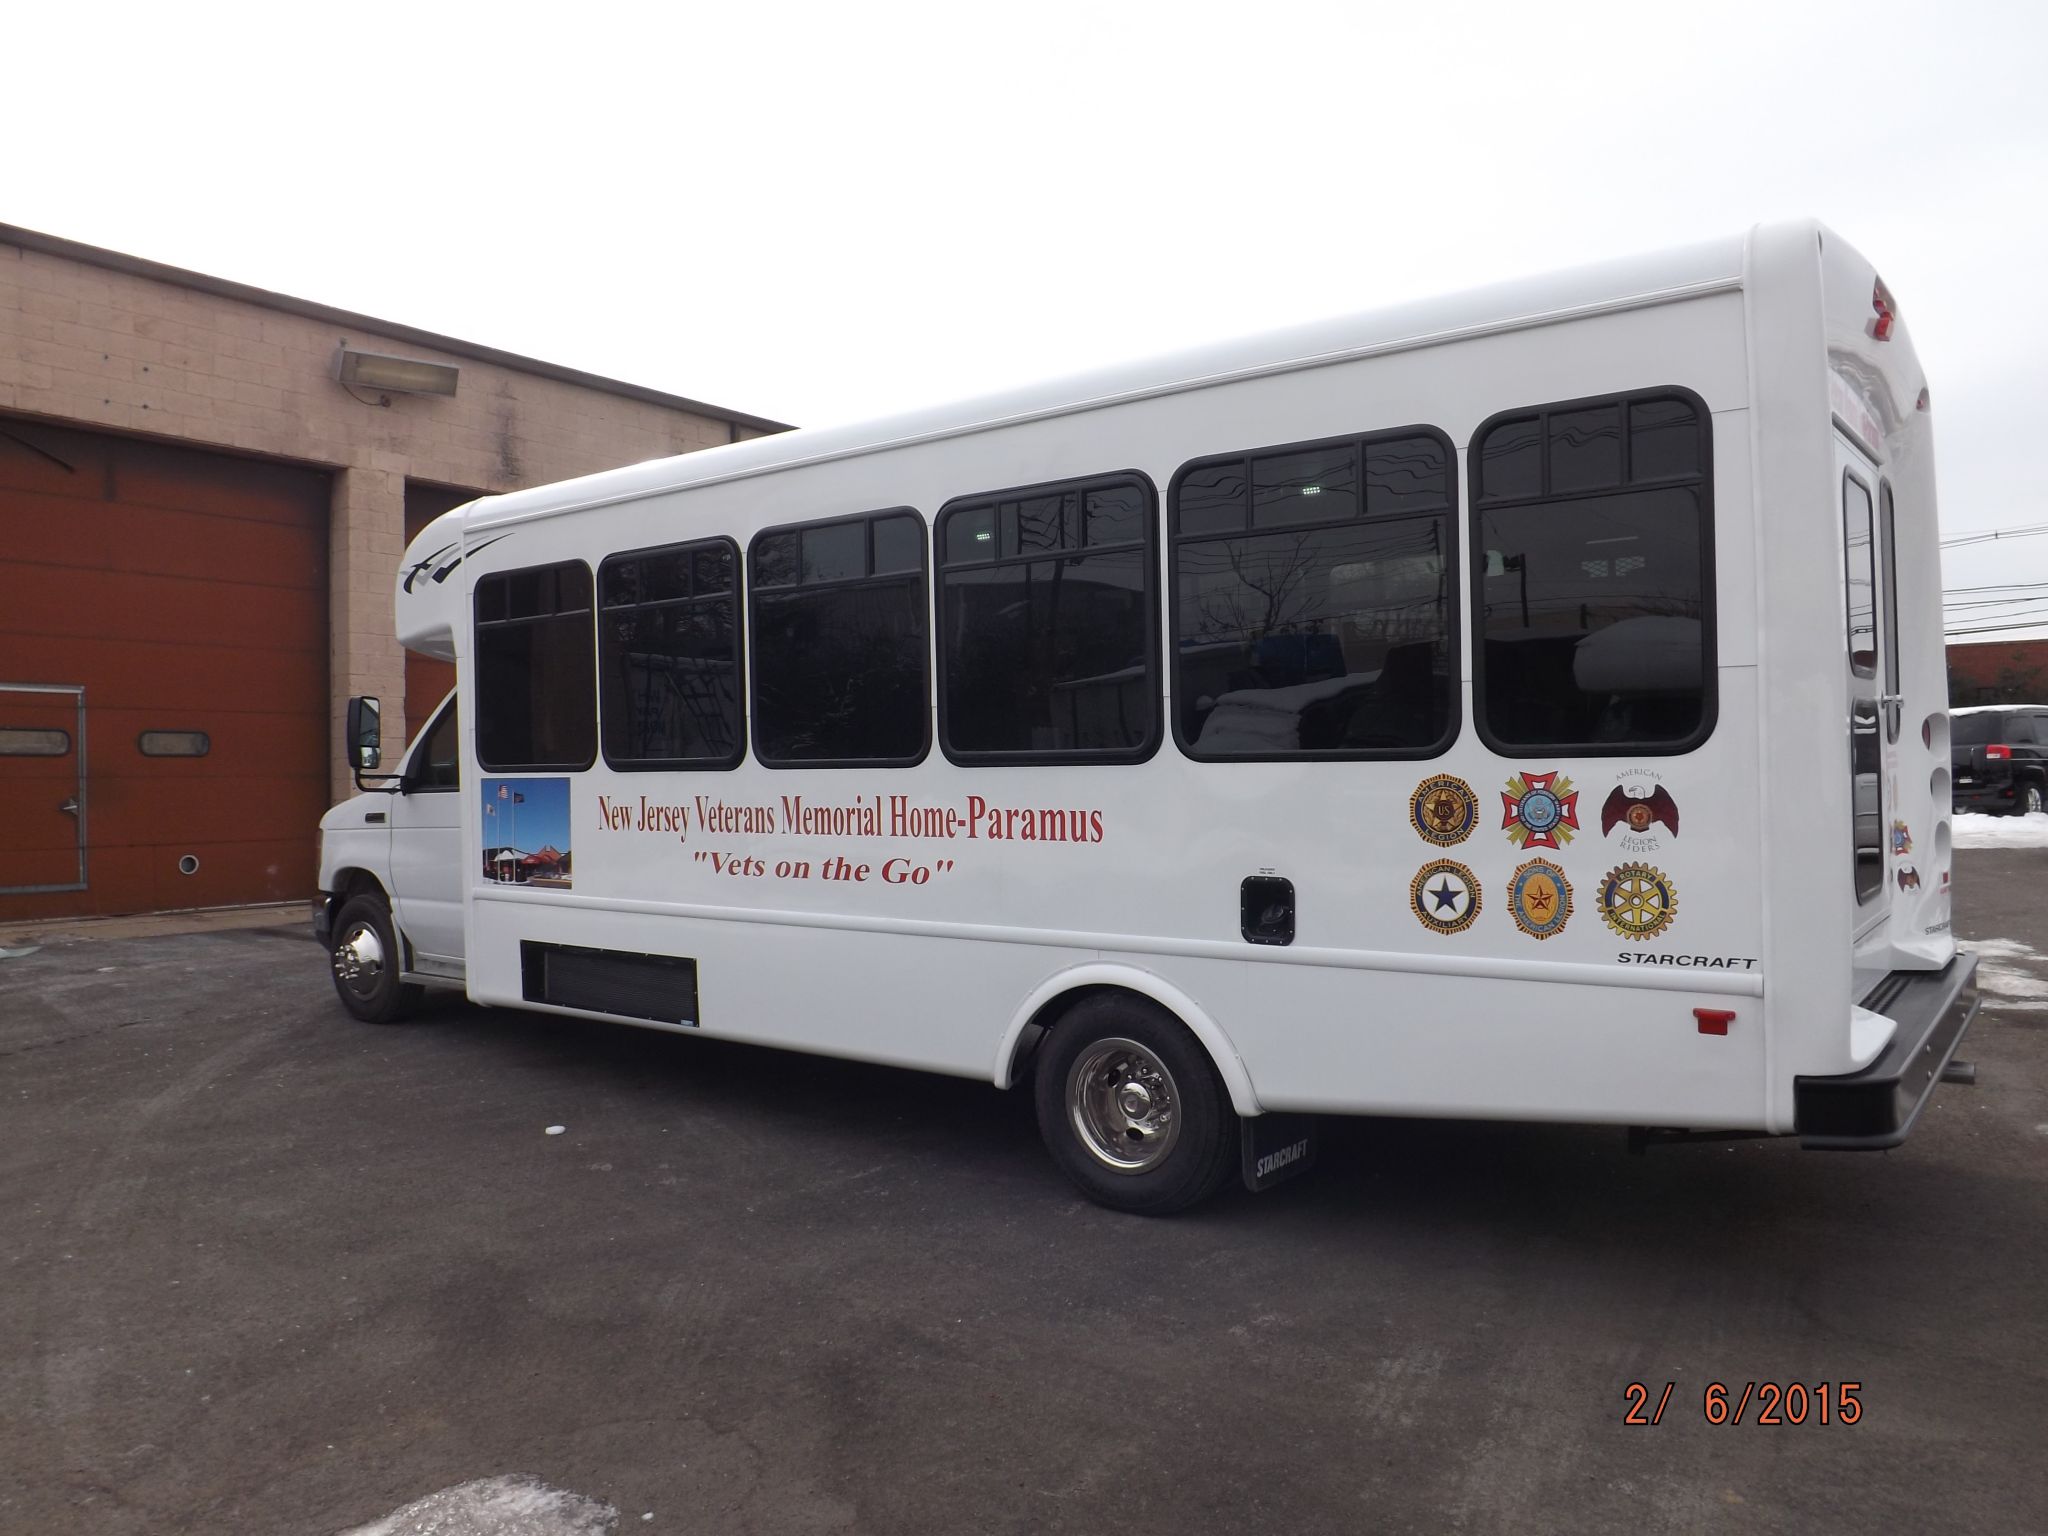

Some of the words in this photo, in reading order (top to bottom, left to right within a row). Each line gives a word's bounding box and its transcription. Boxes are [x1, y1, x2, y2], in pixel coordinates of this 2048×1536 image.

[1616, 768, 1662, 781] AMERICAN
[1418, 781, 1470, 803] AMERICAN
[598, 795, 632, 831] New
[637, 795, 690, 843] Jersey
[694, 795, 775, 834] Veterans
[780, 795, 883, 837] Memorial
[888, 795, 1104, 844] Home-Paramus
[1425, 827, 1464, 840] LEGION
[694, 852, 765, 877] "Vets
[775, 859, 809, 879] on
[821, 856, 870, 881] the
[881, 858, 954, 885] Go"
[1619, 870, 1653, 880] ROTARY
[1417, 866, 1450, 896] AMERICAN
[1421, 911, 1469, 928] AUXILIARY
[1610, 911, 1666, 932] INTERNATIONAL
[1618, 952, 1758, 969] STARCRAFT
[1256, 1139, 1308, 1178] STARCRAFT
